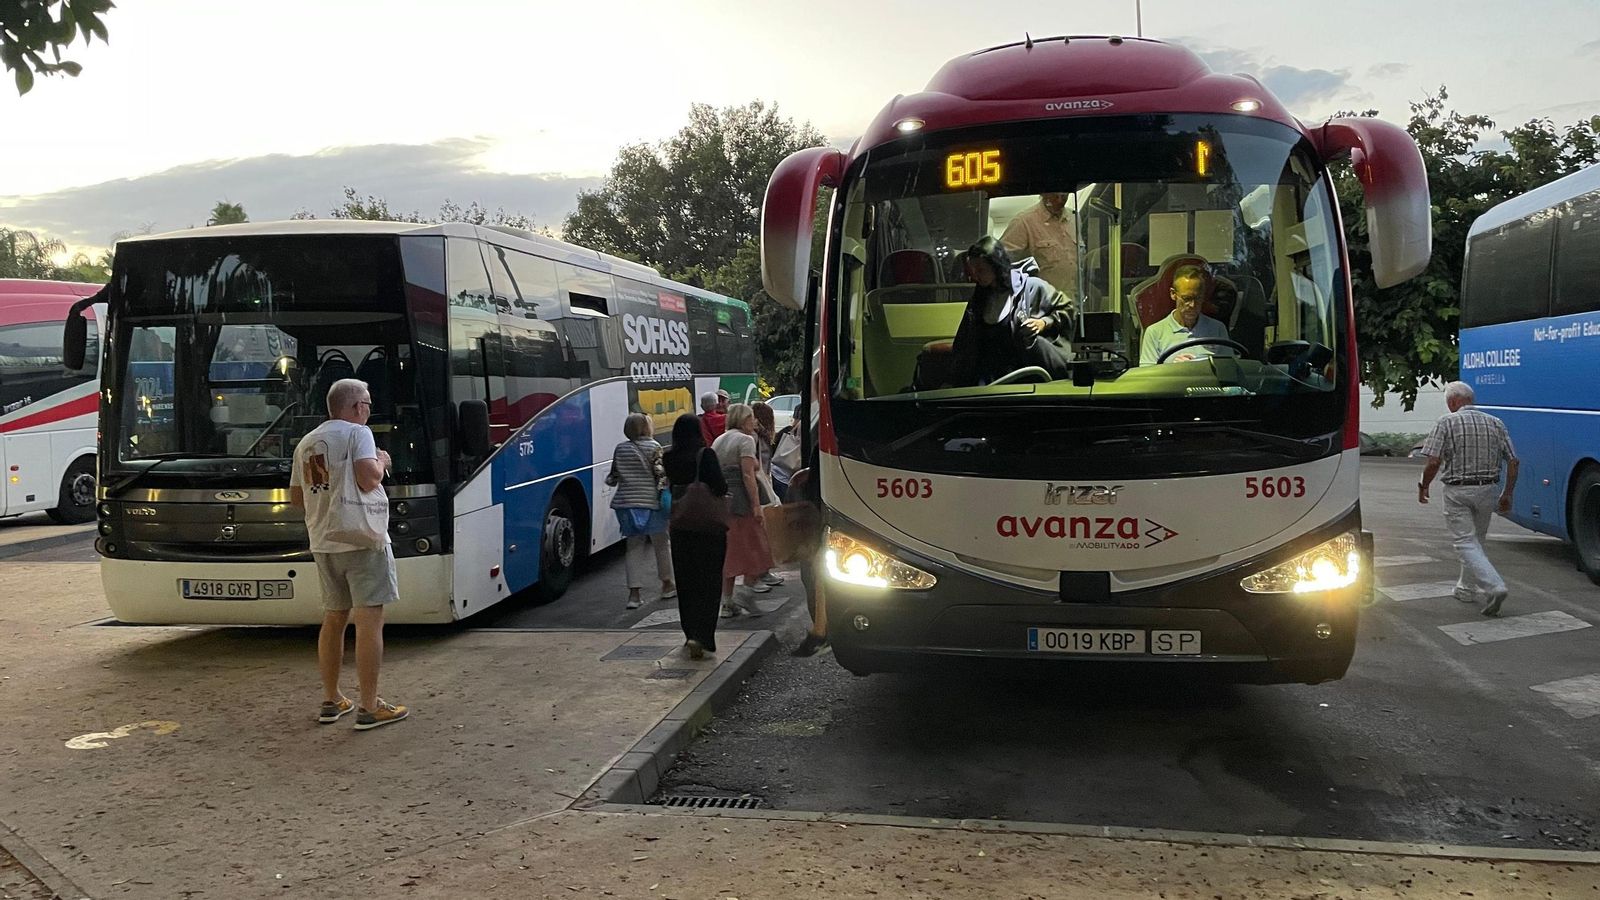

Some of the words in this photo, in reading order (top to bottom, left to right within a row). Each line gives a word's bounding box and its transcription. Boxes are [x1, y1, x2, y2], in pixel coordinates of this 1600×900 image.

[1045, 99, 1100, 111] avanza
[946, 150, 1000, 186] 605
[622, 313, 690, 356] SOFASS
[1463, 352, 1486, 369] ALOHA
[1486, 348, 1521, 367] COLLEGE
[630, 361, 692, 383] COLCHONESS
[876, 478, 933, 499] 5603
[1245, 476, 1306, 498] 5603
[996, 515, 1140, 540] avanza
[193, 582, 223, 596] 4918
[228, 582, 252, 596] GXR
[1045, 631, 1093, 650] 0019
[1100, 632, 1136, 651] KBP
